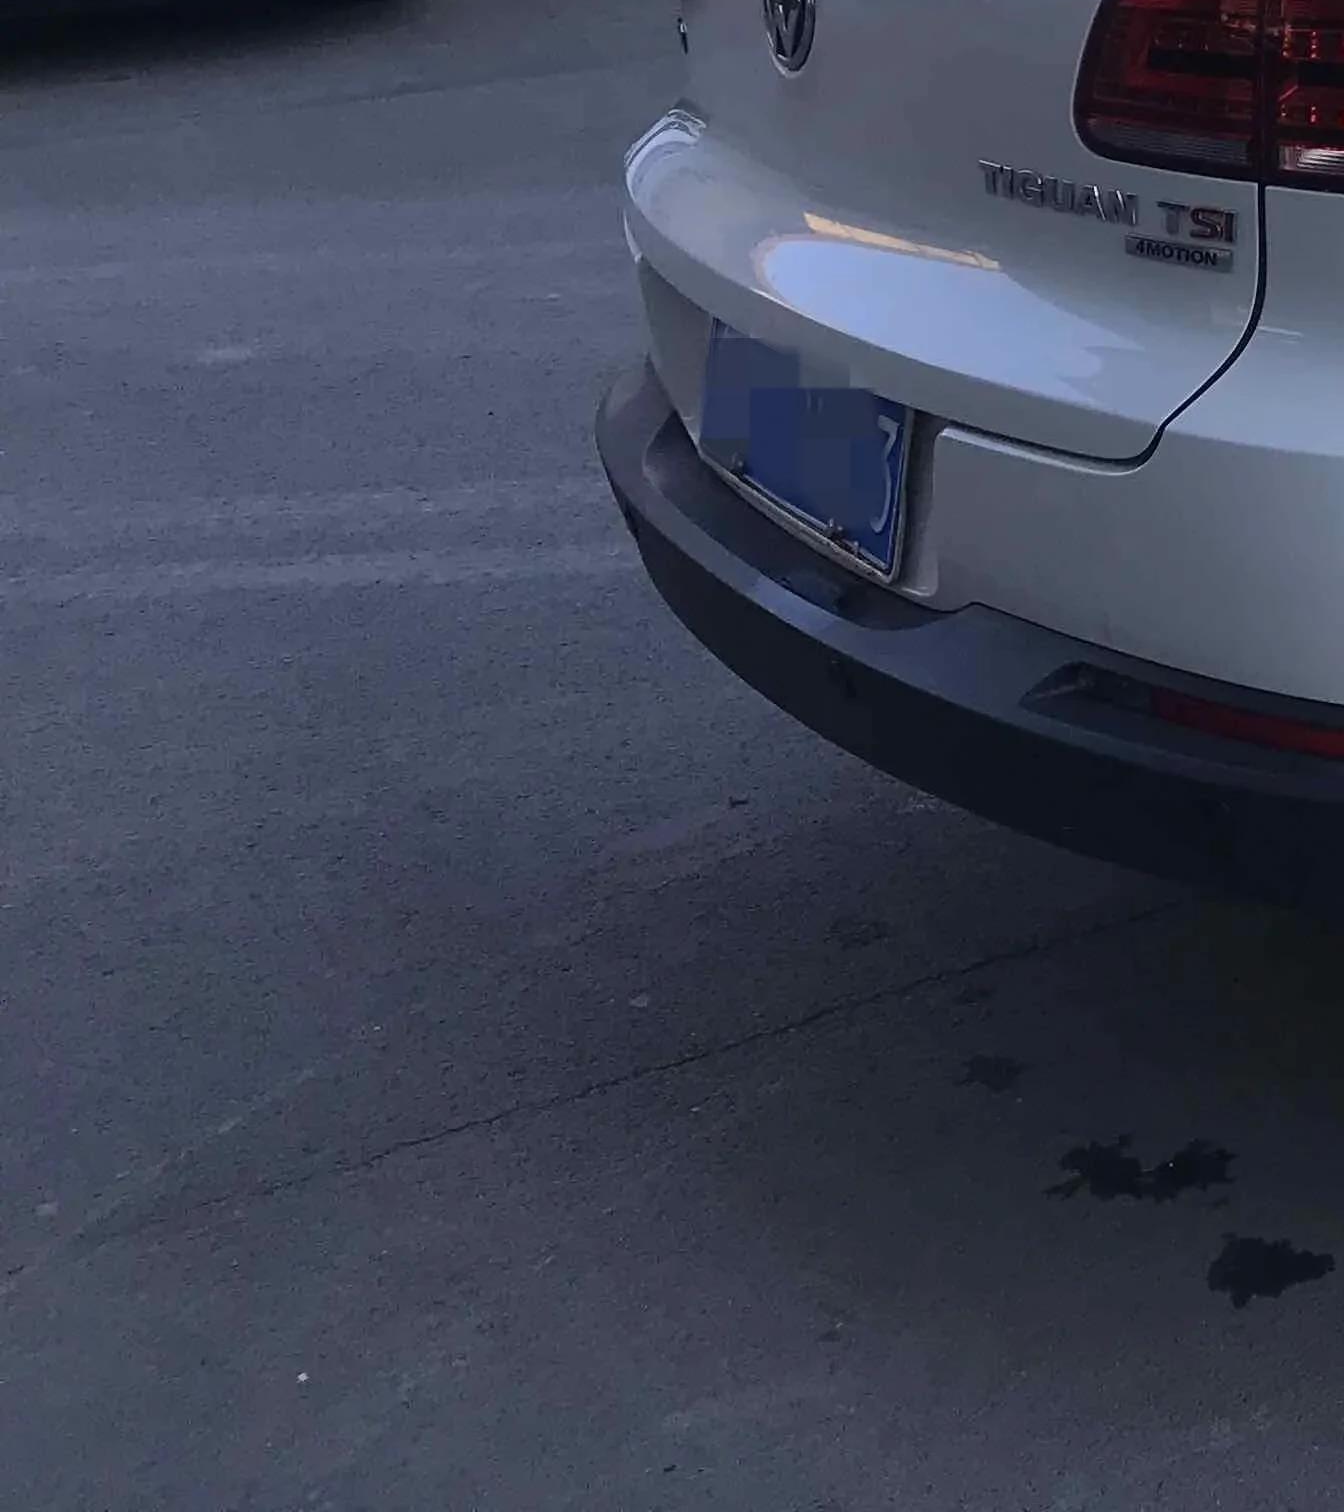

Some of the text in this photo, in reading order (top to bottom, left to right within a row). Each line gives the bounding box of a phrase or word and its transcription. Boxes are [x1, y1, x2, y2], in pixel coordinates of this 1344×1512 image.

[978, 159, 1239, 244] TIGUAN TSI
[1134, 238, 1218, 267] 4MOTION
